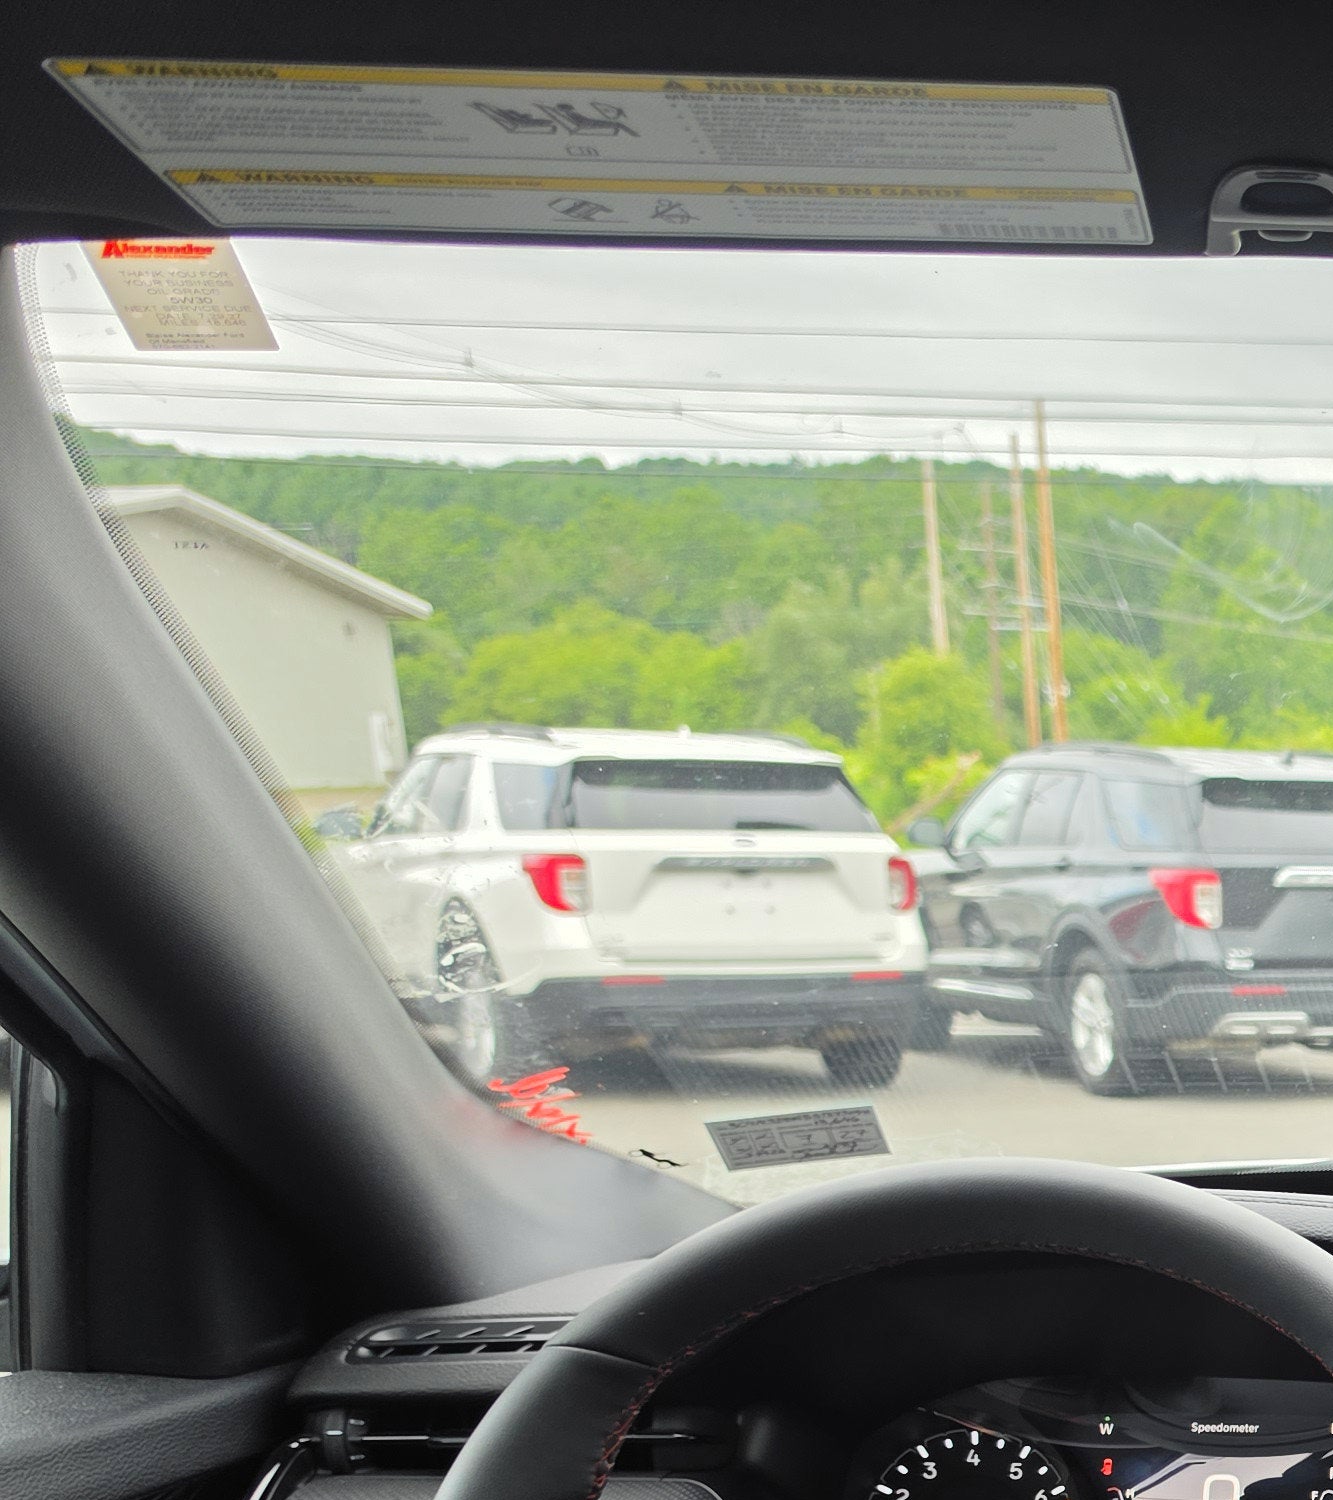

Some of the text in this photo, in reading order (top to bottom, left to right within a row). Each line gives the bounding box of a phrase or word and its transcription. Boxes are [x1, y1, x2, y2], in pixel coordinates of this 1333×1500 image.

[101, 239, 215, 258] Alexander
[1100, 1423, 1114, 1435] W
[1191, 1422, 1260, 1434] Speedometer
[966, 1449, 981, 1466] 4
[922, 1461, 938, 1480] 3
[1009, 1462, 1023, 1480] 5
[1311, 1490, 1319, 1500] F
